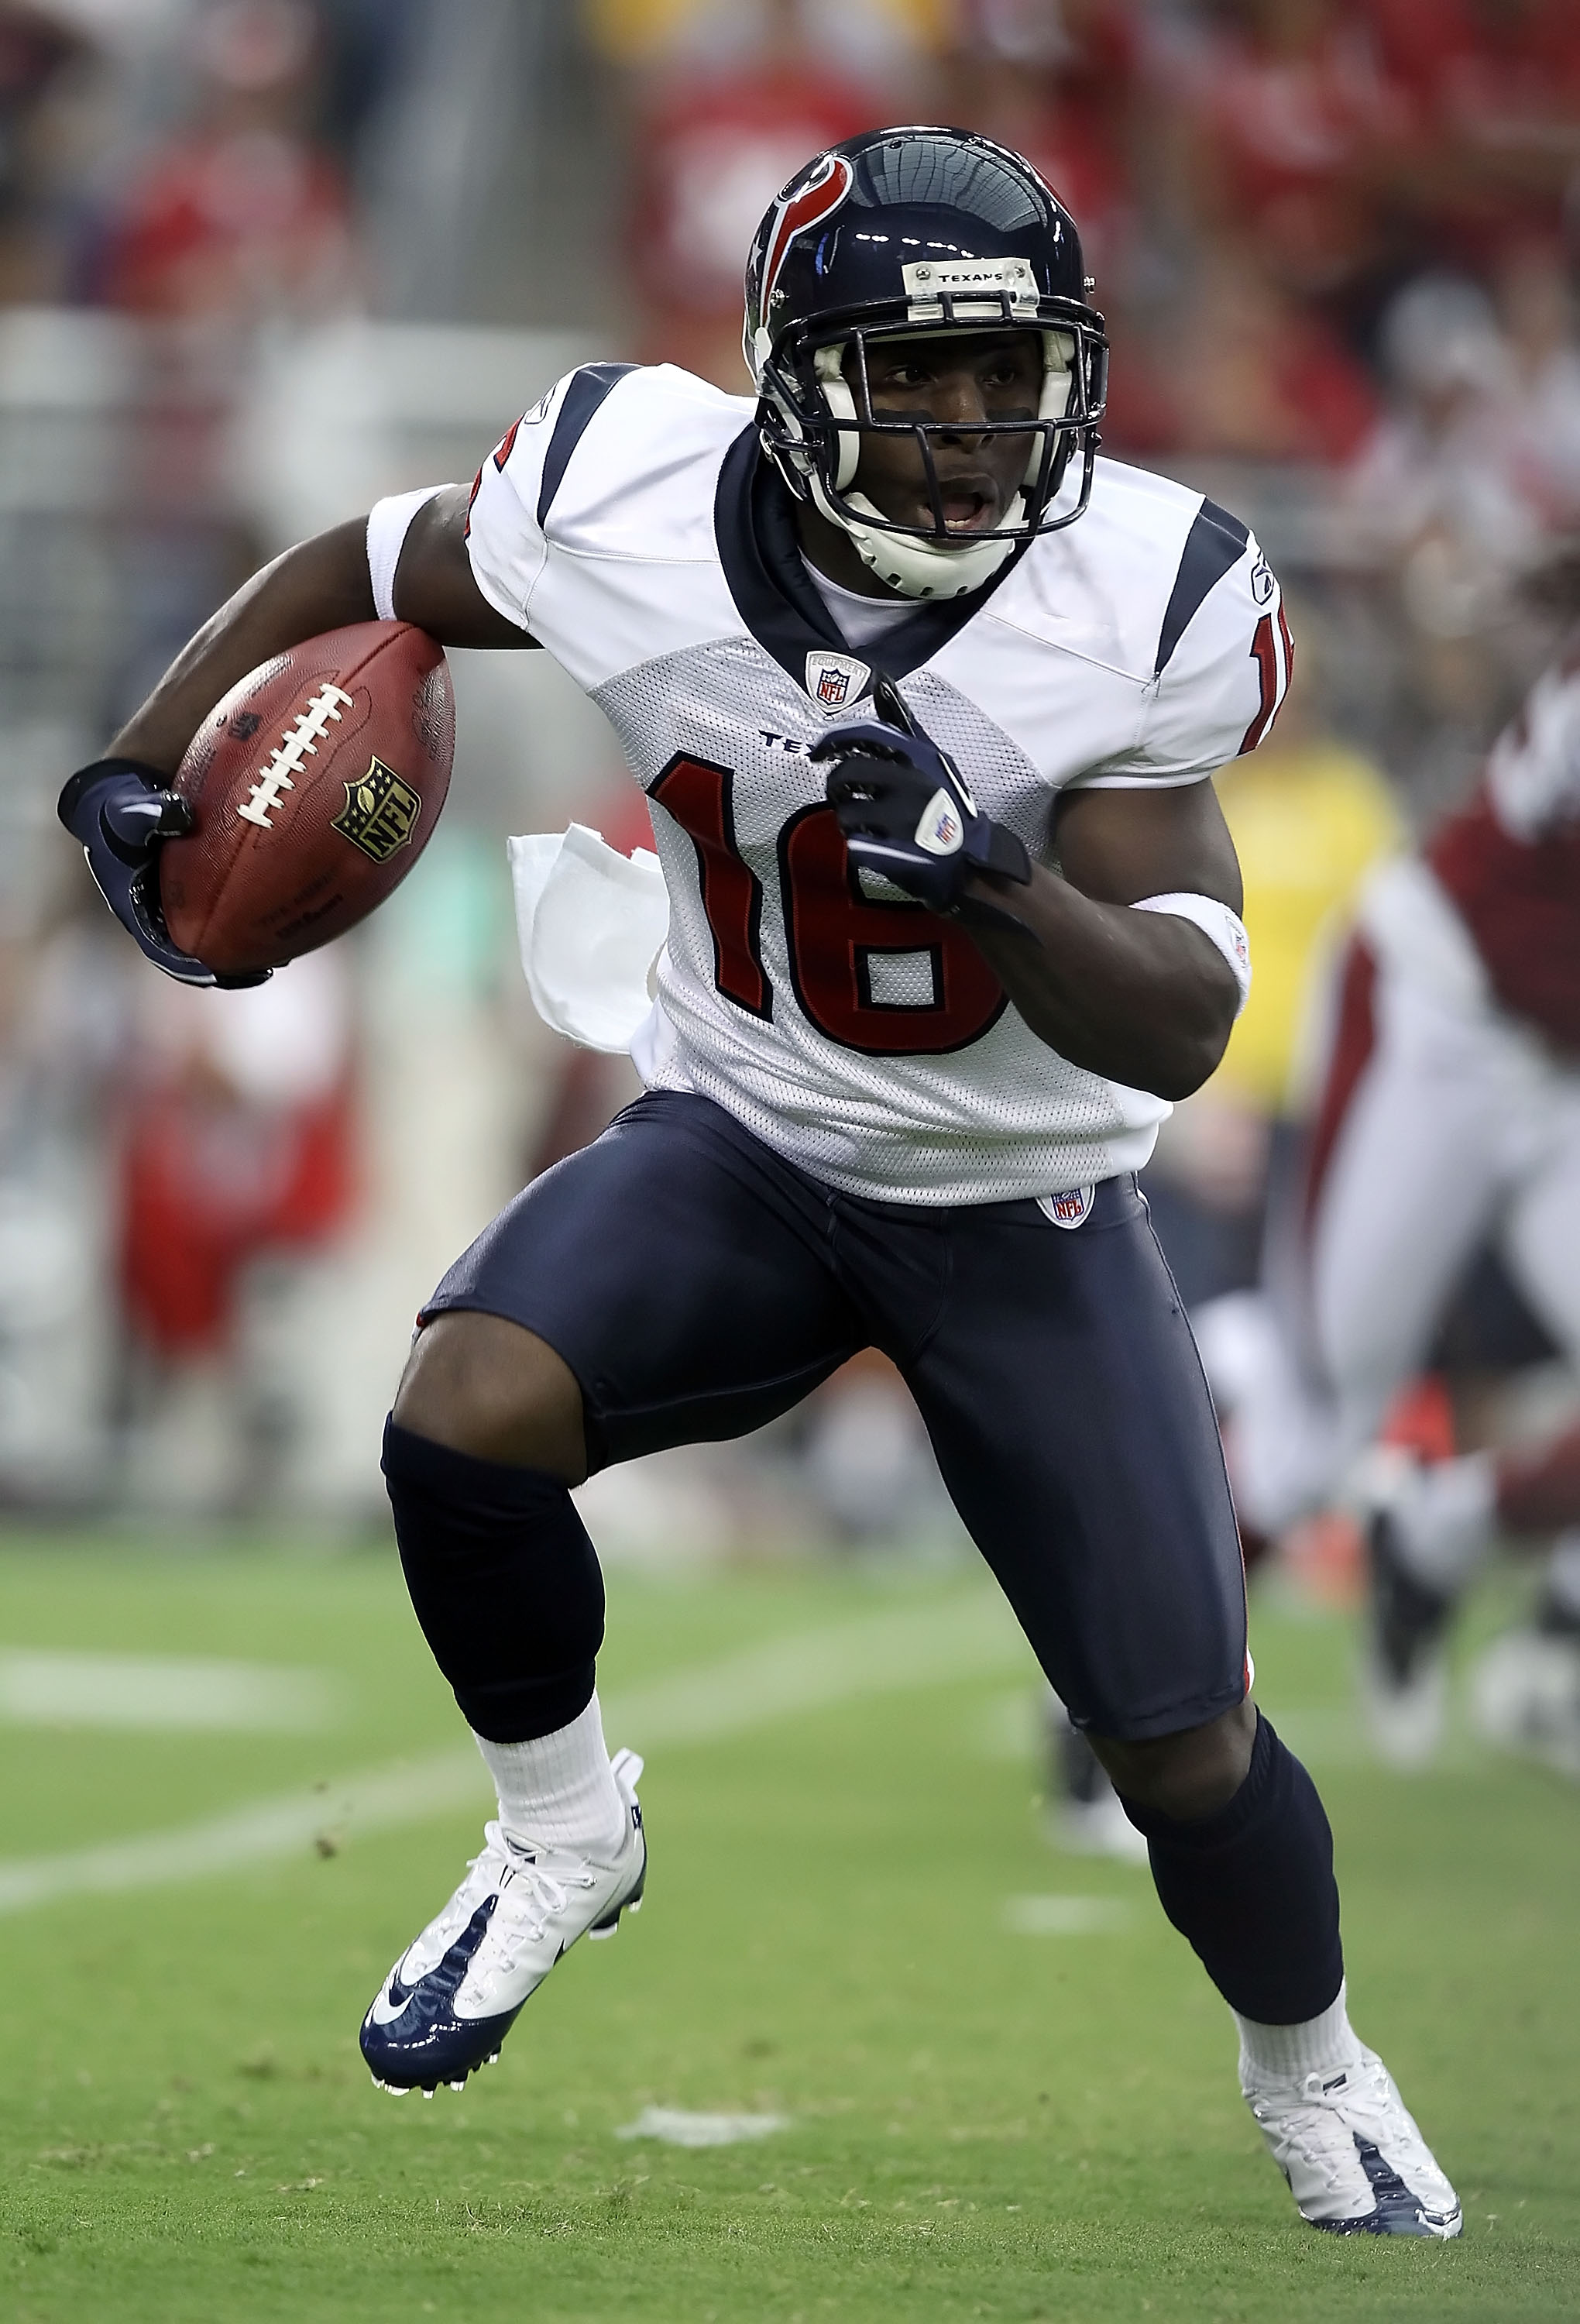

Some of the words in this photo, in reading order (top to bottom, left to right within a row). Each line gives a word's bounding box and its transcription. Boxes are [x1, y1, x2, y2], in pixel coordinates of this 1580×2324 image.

[938, 273, 1003, 283] TEXANS
[819, 682, 843, 701] NFL
[362, 792, 417, 854] NFL
[1056, 1200, 1082, 1218] NFL
